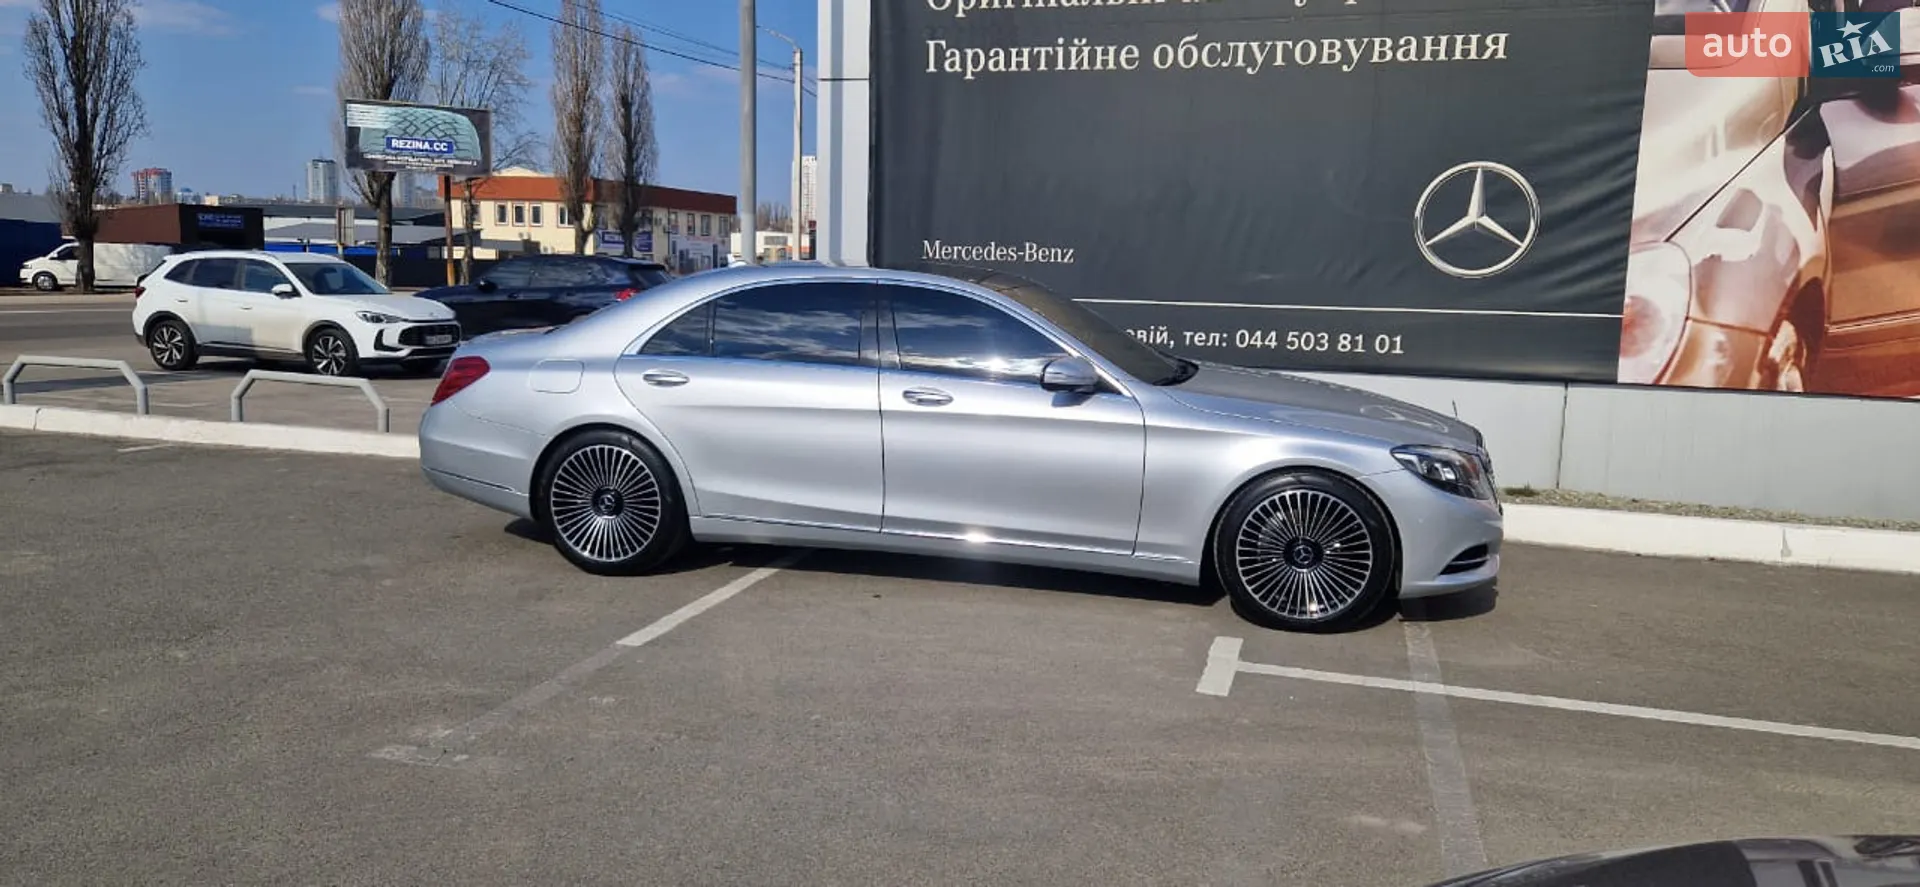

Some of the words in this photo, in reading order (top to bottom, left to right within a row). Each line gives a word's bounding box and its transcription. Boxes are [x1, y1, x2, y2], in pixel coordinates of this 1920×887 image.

[925, 36, 1140, 80] Гарантійне
[1152, 31, 1511, 75] обслуговування
[391, 139, 448, 151] REZINA.CC
[921, 239, 1075, 264] Mercedes-Benz
[1182, 330, 1229, 348] тел:
[1235, 328, 1278, 350] 044
[1286, 331, 1330, 352] 503
[1337, 333, 1366, 353] 81
[1374, 334, 1405, 355] 01
